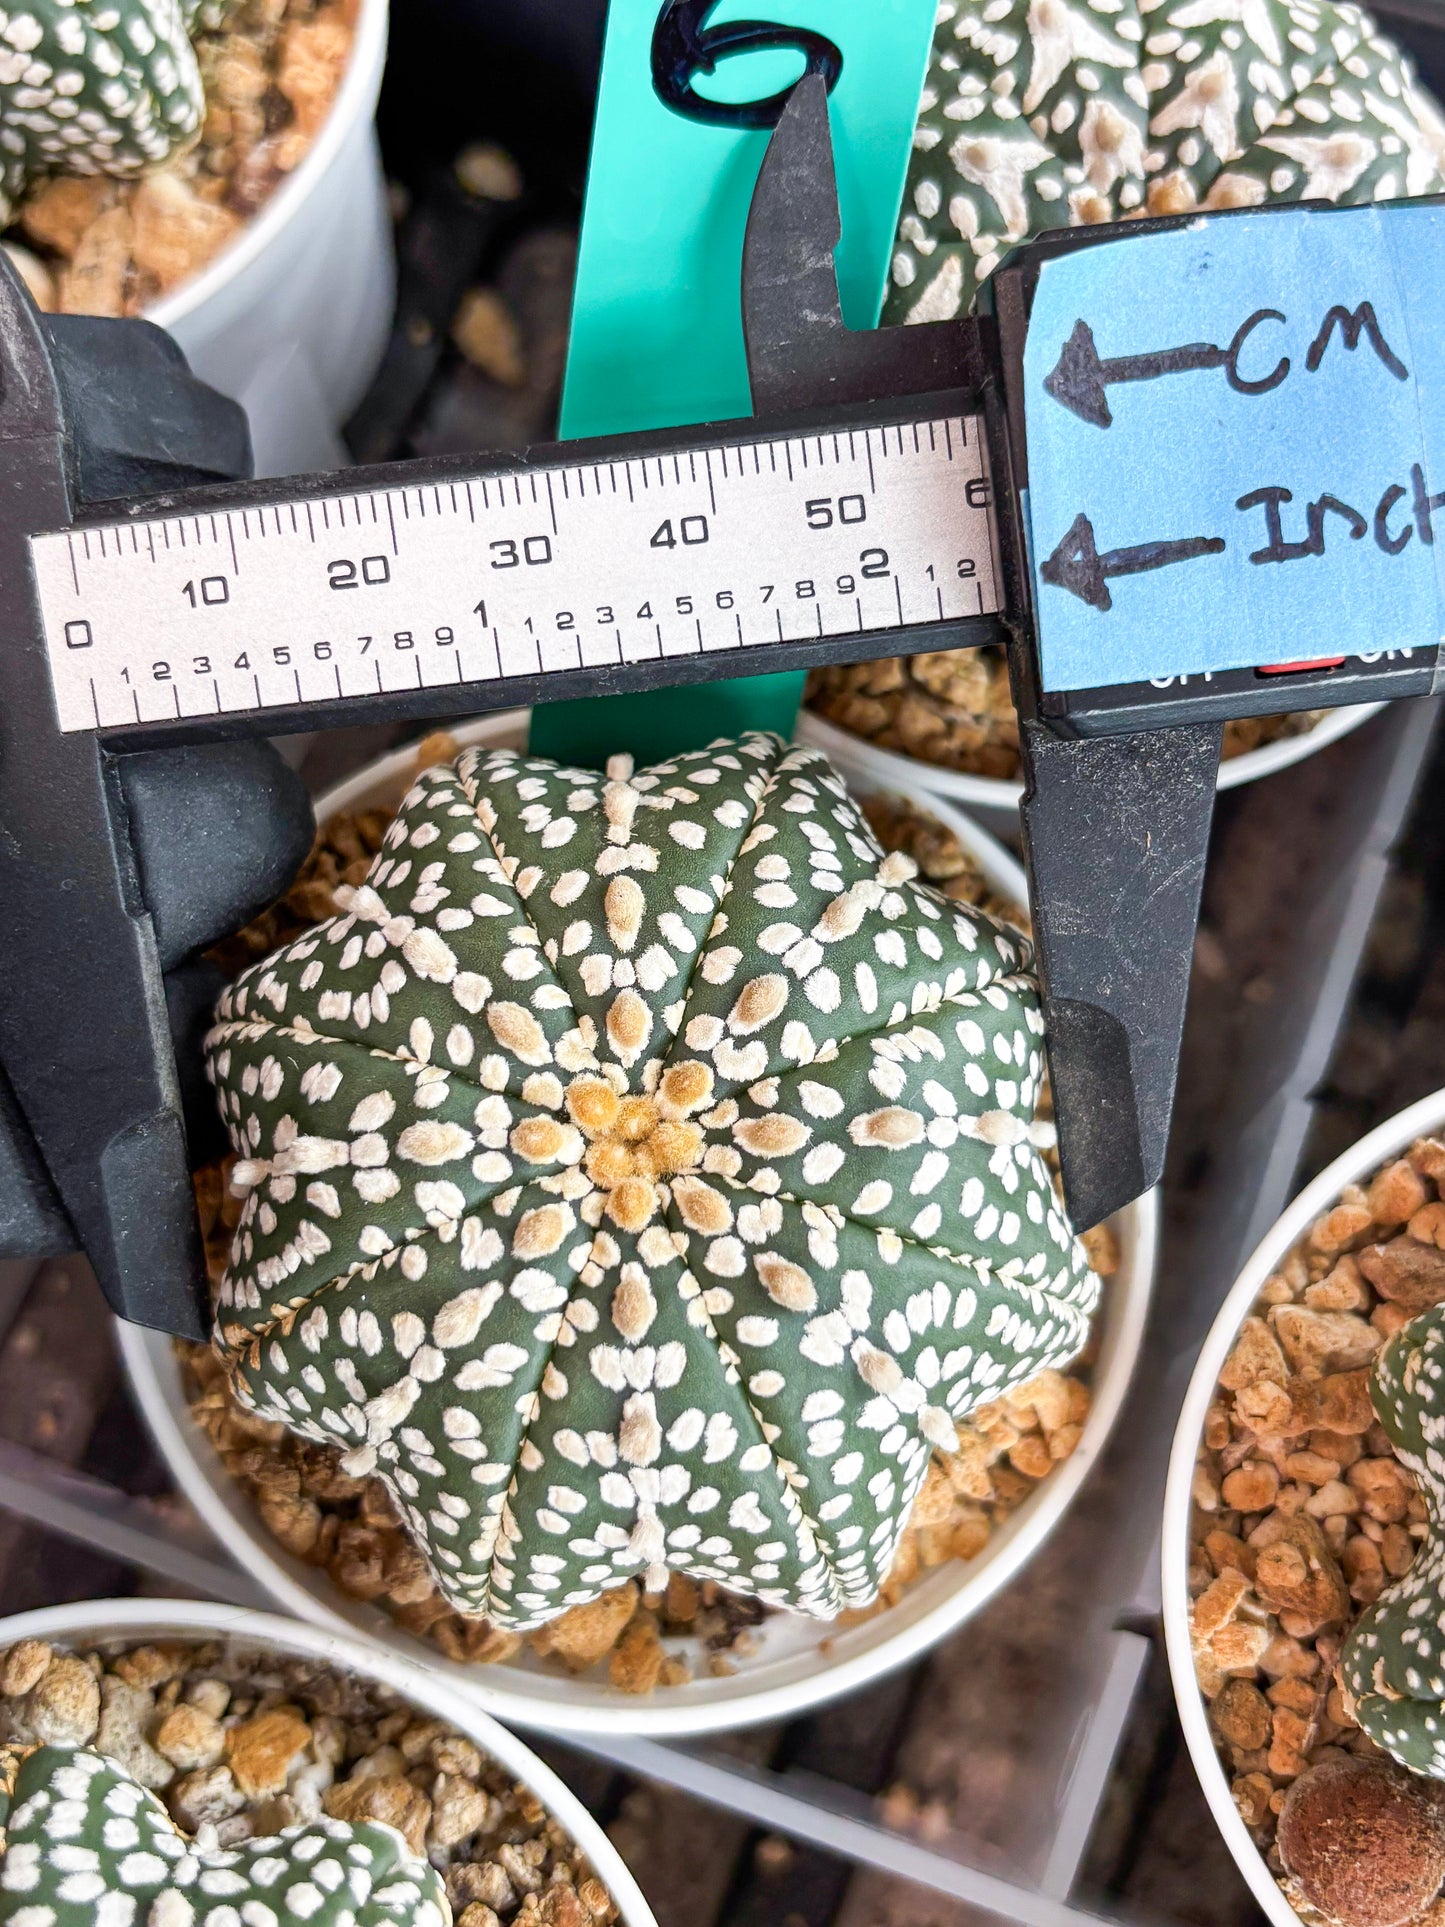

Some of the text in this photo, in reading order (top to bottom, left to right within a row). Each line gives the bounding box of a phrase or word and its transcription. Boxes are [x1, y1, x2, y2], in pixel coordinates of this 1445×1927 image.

[651, 0, 843, 130] 6
[65, 620, 92, 649] 0
[182, 576, 229, 607] 10
[328, 556, 390, 590] 20
[490, 536, 552, 568] 30
[650, 516, 709, 549] 40
[805, 495, 866, 529] 50
[121, 548, 976, 684] 1 2 3 4 5 6 7 8 9 1 1 2 3 4 5 6 7 8 9 2 1 2
